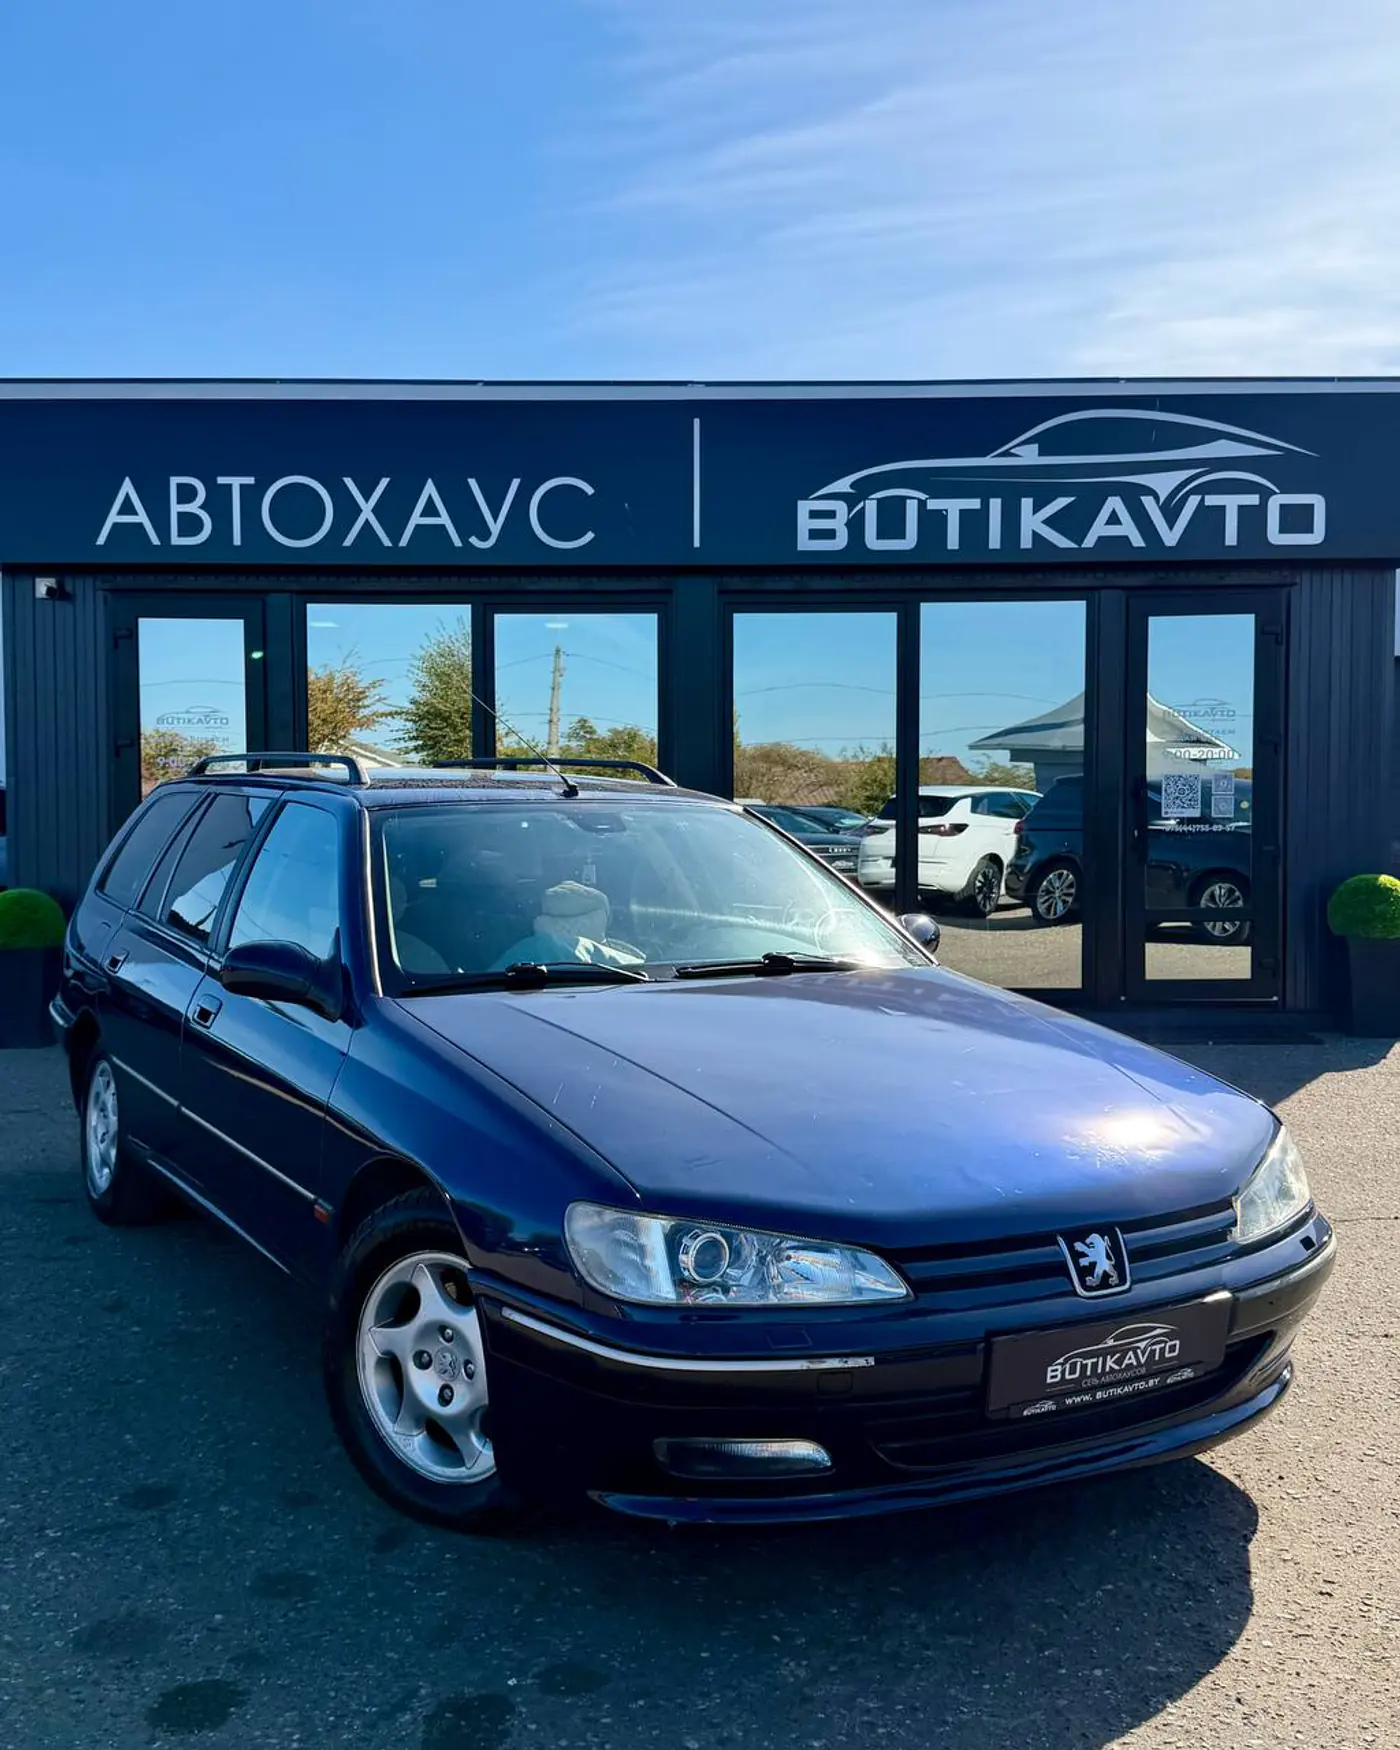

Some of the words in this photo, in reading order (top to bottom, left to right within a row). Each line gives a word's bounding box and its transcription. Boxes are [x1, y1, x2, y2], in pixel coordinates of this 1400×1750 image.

[96, 475, 596, 549] АВТОХАУС
[797, 492, 1326, 551] BUTIKAVTO
[1046, 1339, 1181, 1384] BUTIKAVTO
